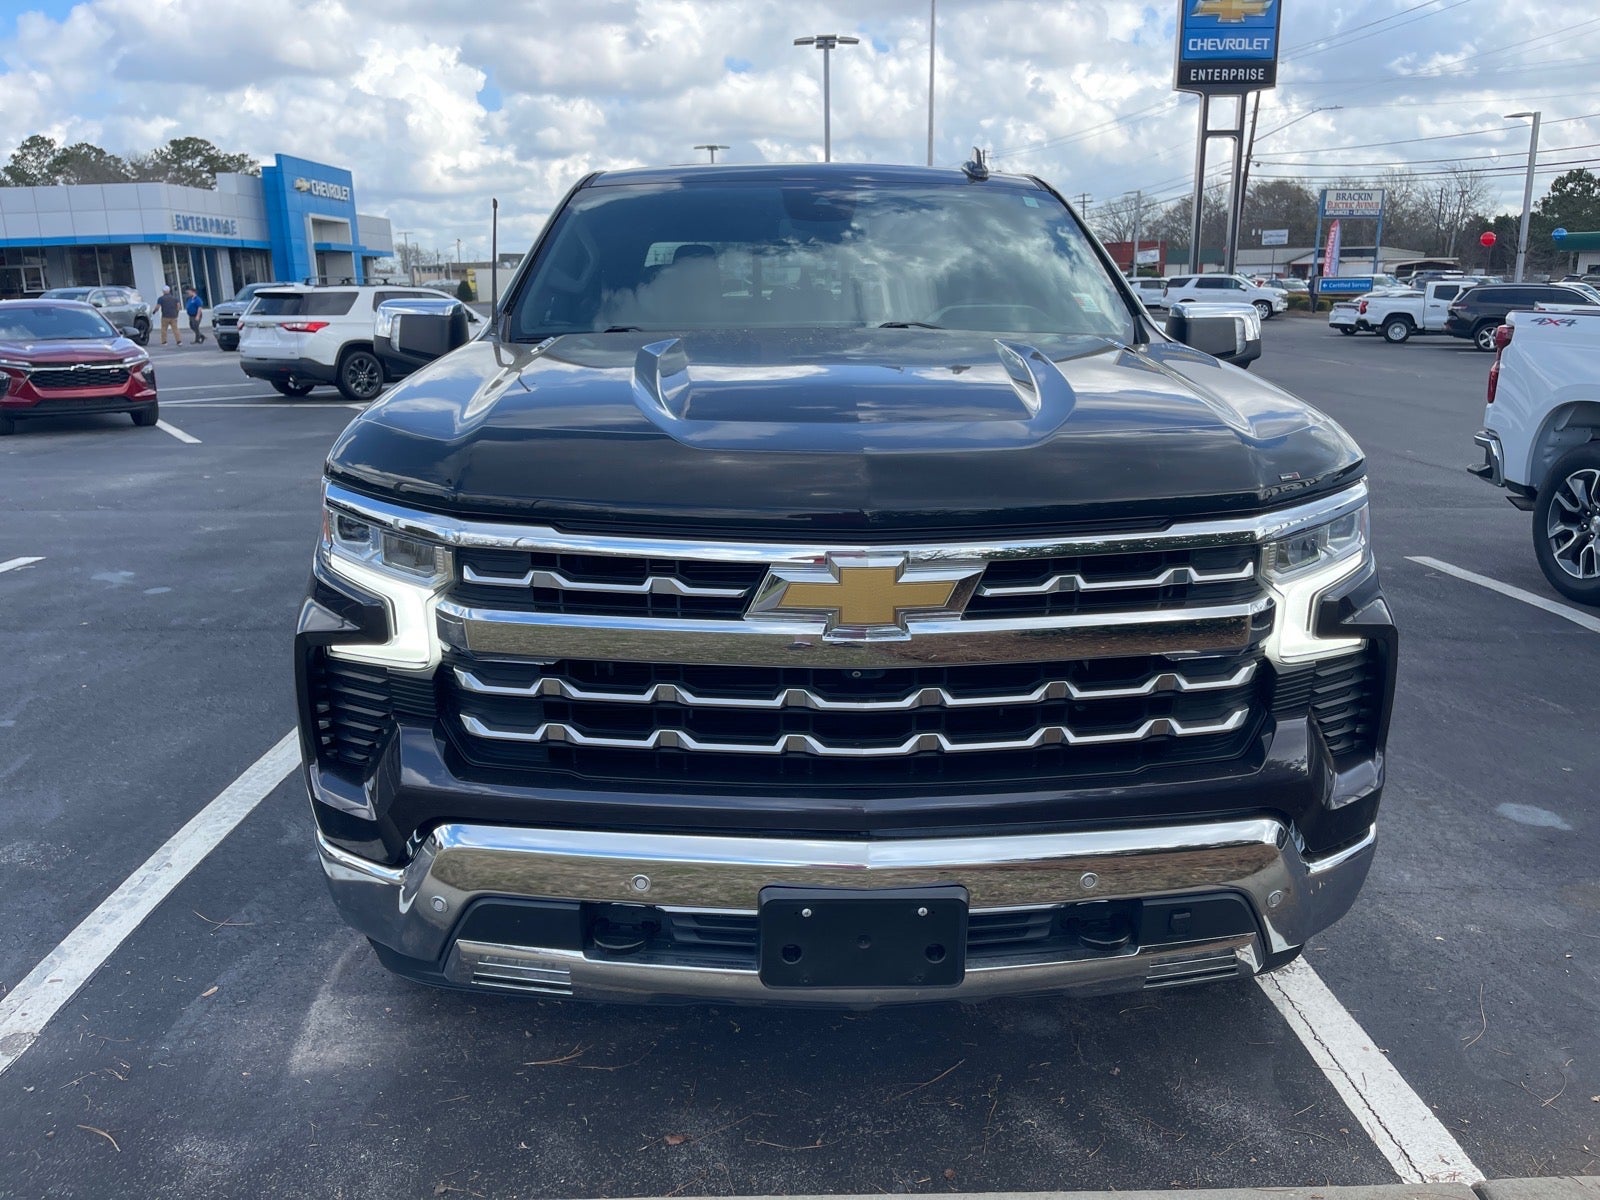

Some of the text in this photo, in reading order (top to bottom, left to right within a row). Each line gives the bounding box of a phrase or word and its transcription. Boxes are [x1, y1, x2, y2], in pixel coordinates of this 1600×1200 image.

[1188, 38, 1270, 51] CHEVROLET
[1190, 68, 1265, 81] ENTERPRISE
[311, 179, 350, 201] CHEVROLET
[1335, 192, 1373, 201] BRACKIN
[1327, 200, 1380, 209] ELECTRIC AVENUE
[174, 213, 237, 236] ENTERPRISE
[1328, 281, 1370, 289] Certified Service
